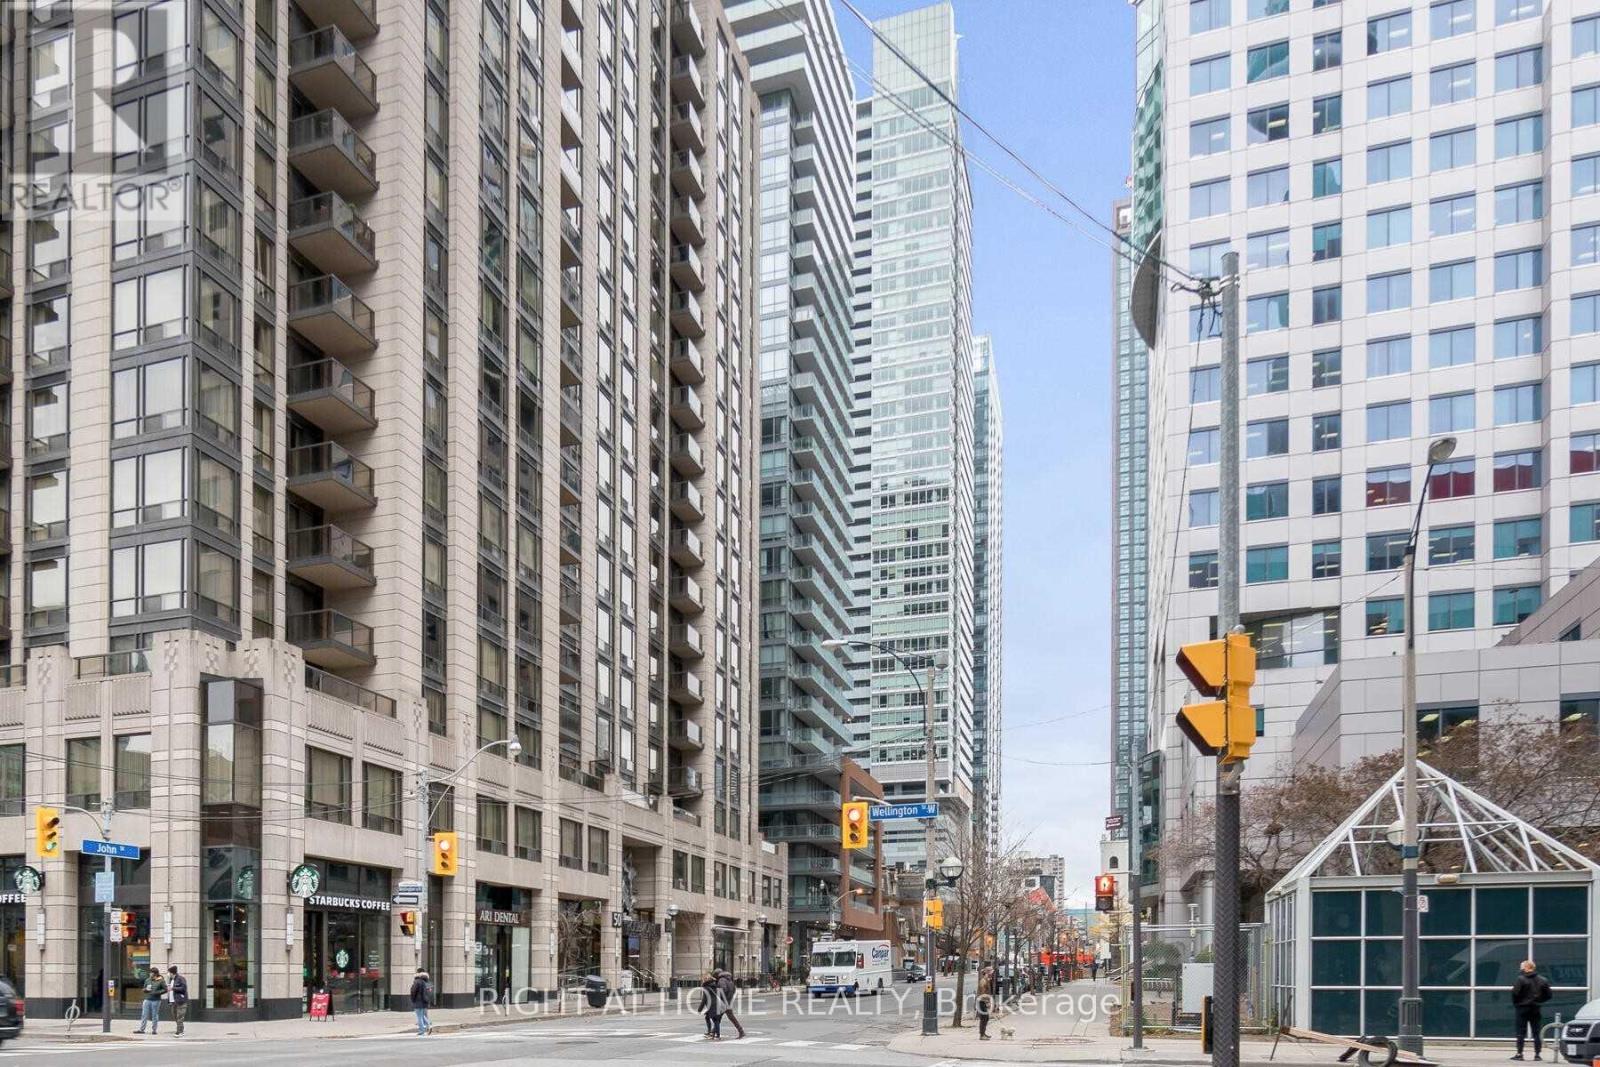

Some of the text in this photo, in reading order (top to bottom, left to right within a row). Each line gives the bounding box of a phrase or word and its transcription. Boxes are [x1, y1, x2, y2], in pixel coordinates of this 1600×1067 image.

[872, 806, 918, 817] Wellington
[927, 804, 936, 814] W
[97, 844, 117, 854] John
[0, 894, 26, 904] FFEE
[309, 895, 391, 911] STARBUCKS COFFEE
[494, 911, 520, 924] DENTAL
[613, 912, 622, 927] 50
